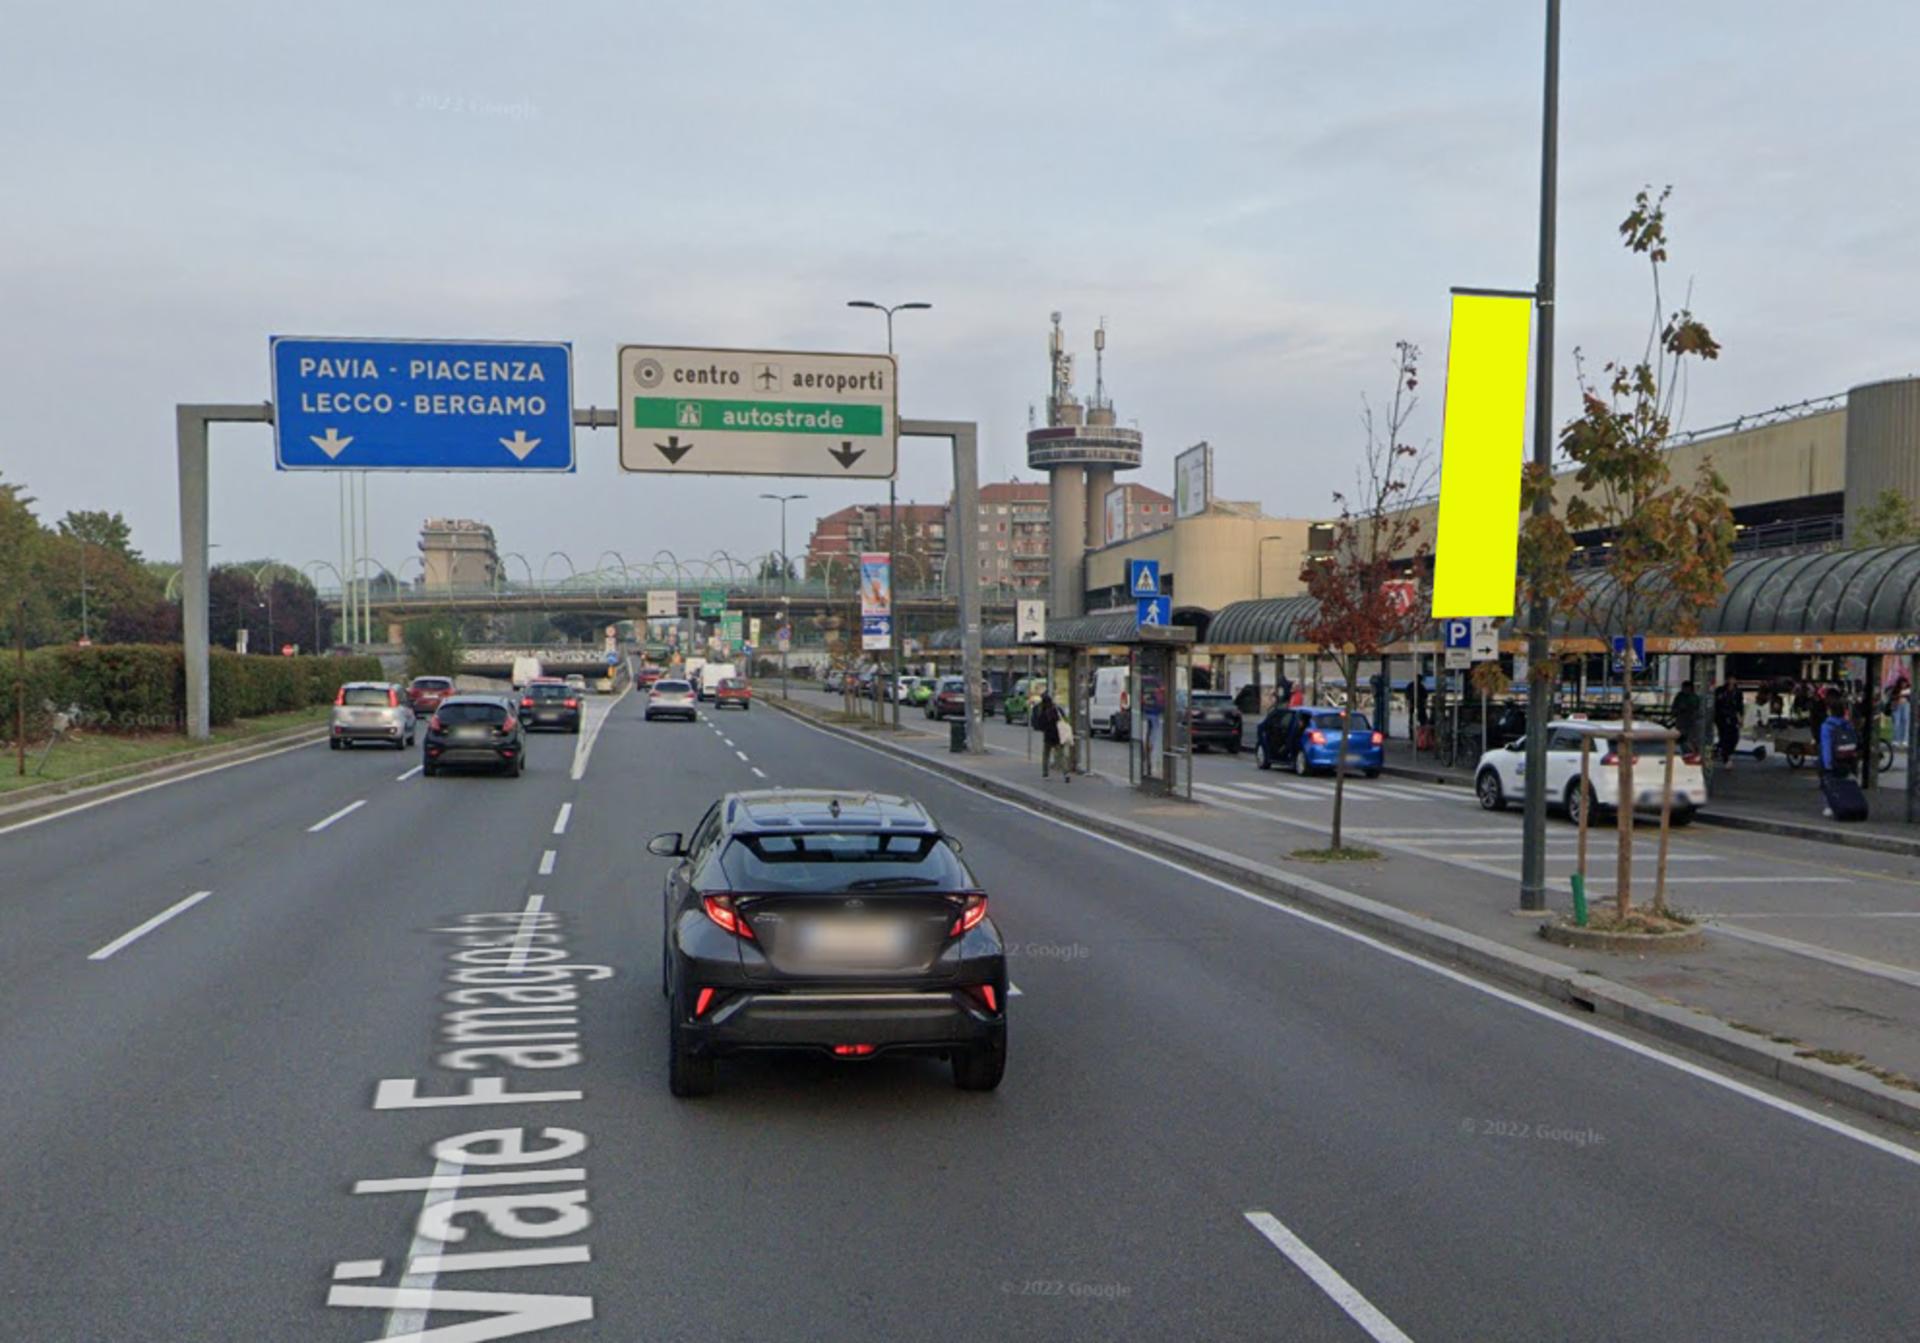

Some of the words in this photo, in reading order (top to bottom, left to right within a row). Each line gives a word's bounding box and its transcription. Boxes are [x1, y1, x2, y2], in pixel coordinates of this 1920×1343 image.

[299, 357, 380, 379] PAVIA
[409, 359, 546, 382] PIACENZA
[673, 364, 741, 386] centro
[792, 370, 883, 394] aeroporti
[301, 392, 393, 414] LECCO
[413, 394, 547, 416] BERGAMO
[722, 409, 845, 429] autostrade
[1449, 622, 1468, 647] P
